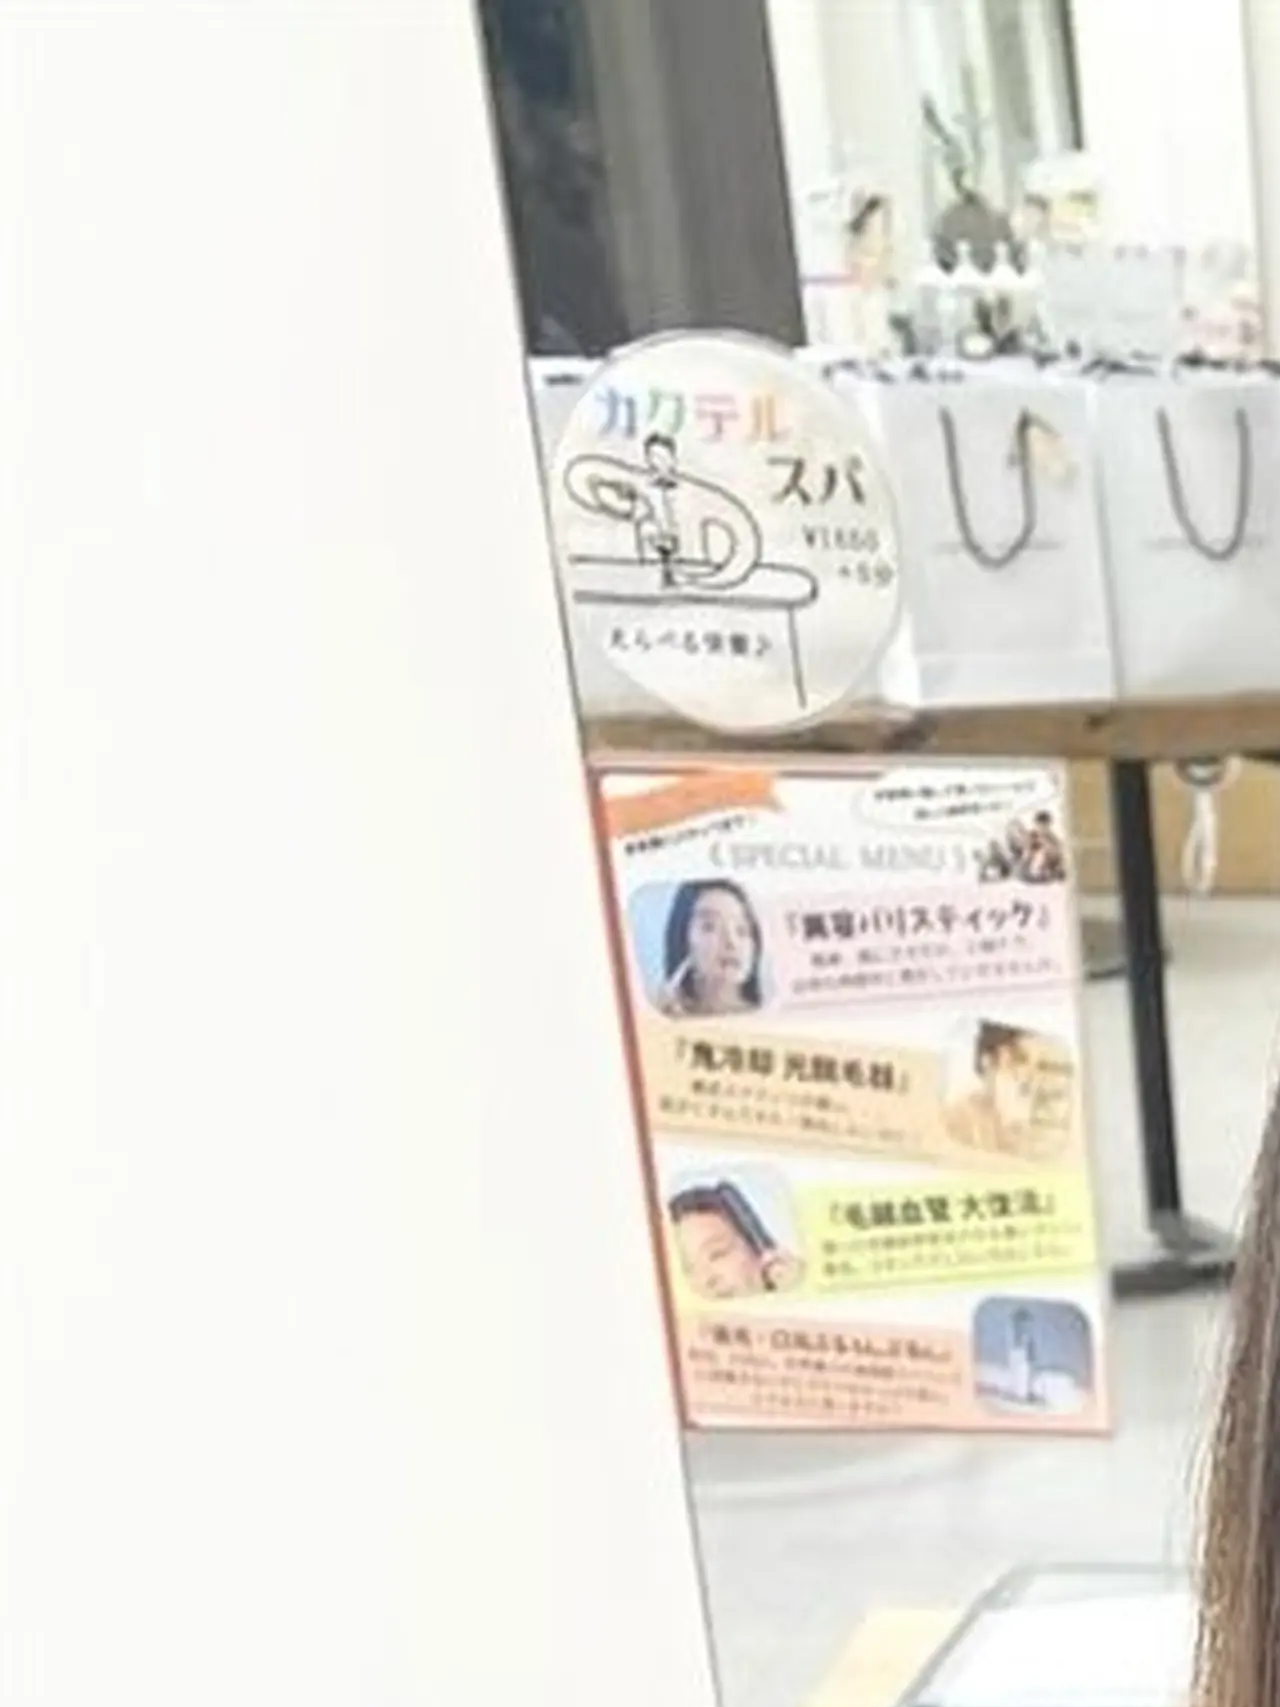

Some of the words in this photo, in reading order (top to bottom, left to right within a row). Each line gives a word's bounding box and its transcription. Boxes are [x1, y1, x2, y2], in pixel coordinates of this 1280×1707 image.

[594, 390, 792, 445] カクテル
[766, 454, 868, 506] スパ
